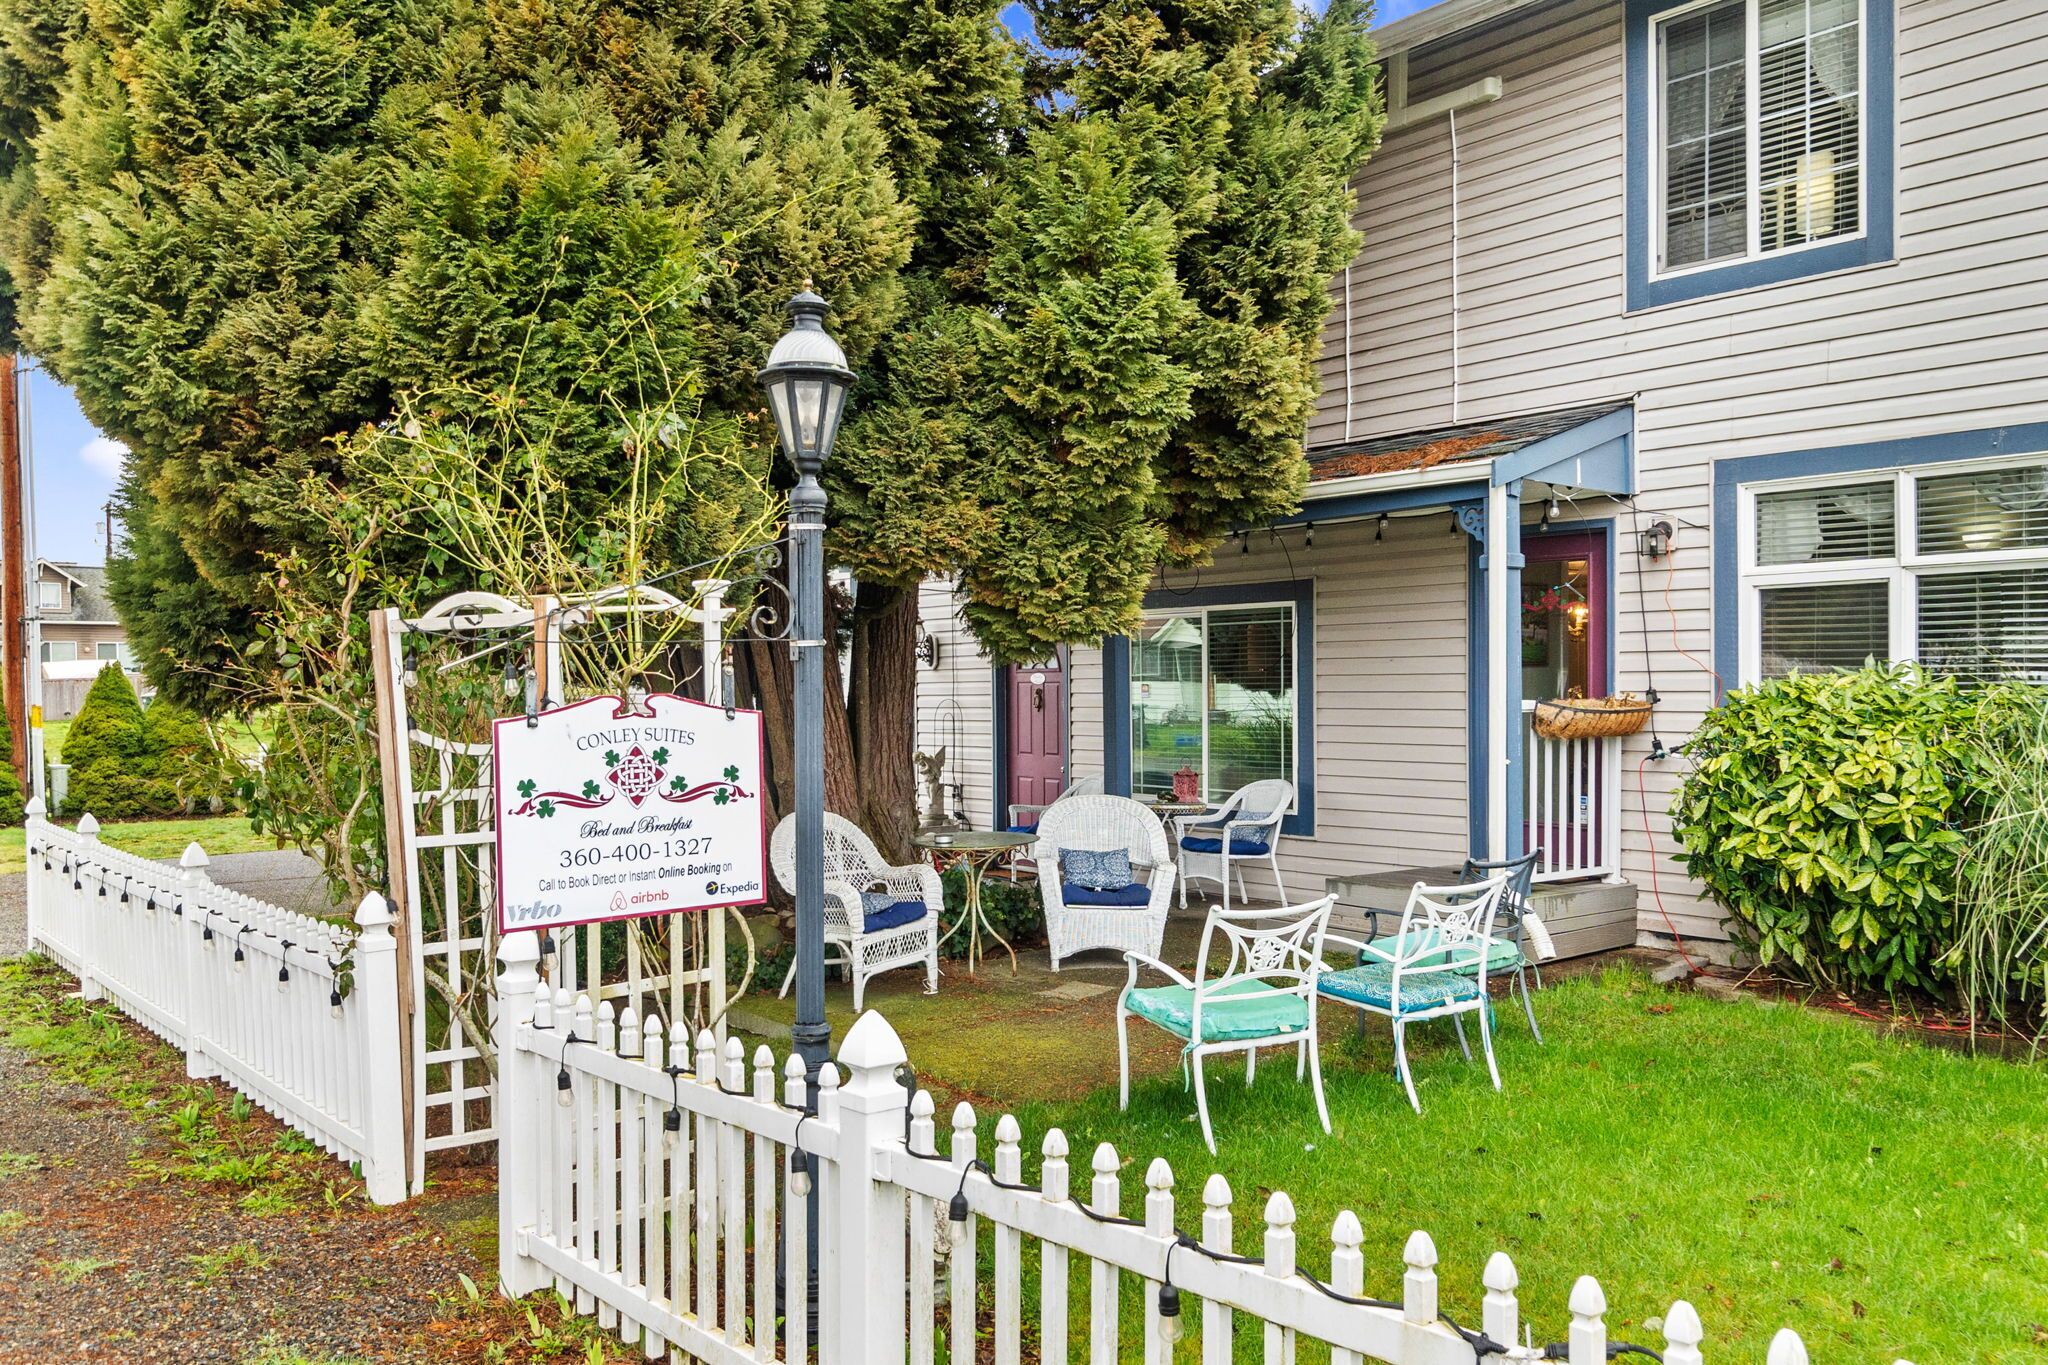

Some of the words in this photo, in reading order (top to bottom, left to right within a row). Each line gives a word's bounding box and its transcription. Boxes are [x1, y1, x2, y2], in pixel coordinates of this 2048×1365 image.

[576, 728, 640, 751] CONLEY
[644, 727, 695, 746] SUITES
[580, 820, 612, 839] Bed
[612, 821, 636, 836] and
[638, 816, 692, 836] Breakfast
[560, 837, 712, 868] 360-400-1327
[539, 879, 555, 892] Call
[558, 879, 566, 889] to
[569, 876, 590, 888] Book
[593, 874, 616, 886] Direct
[619, 873, 627, 883] or
[629, 870, 656, 881] Instant
[658, 866, 685, 879] Online
[687, 863, 721, 876] Booking
[723, 862, 732, 872] on
[720, 881, 759, 895] Expedia
[631, 890, 669, 904] airbnb
[507, 900, 562, 922] Vrbo
